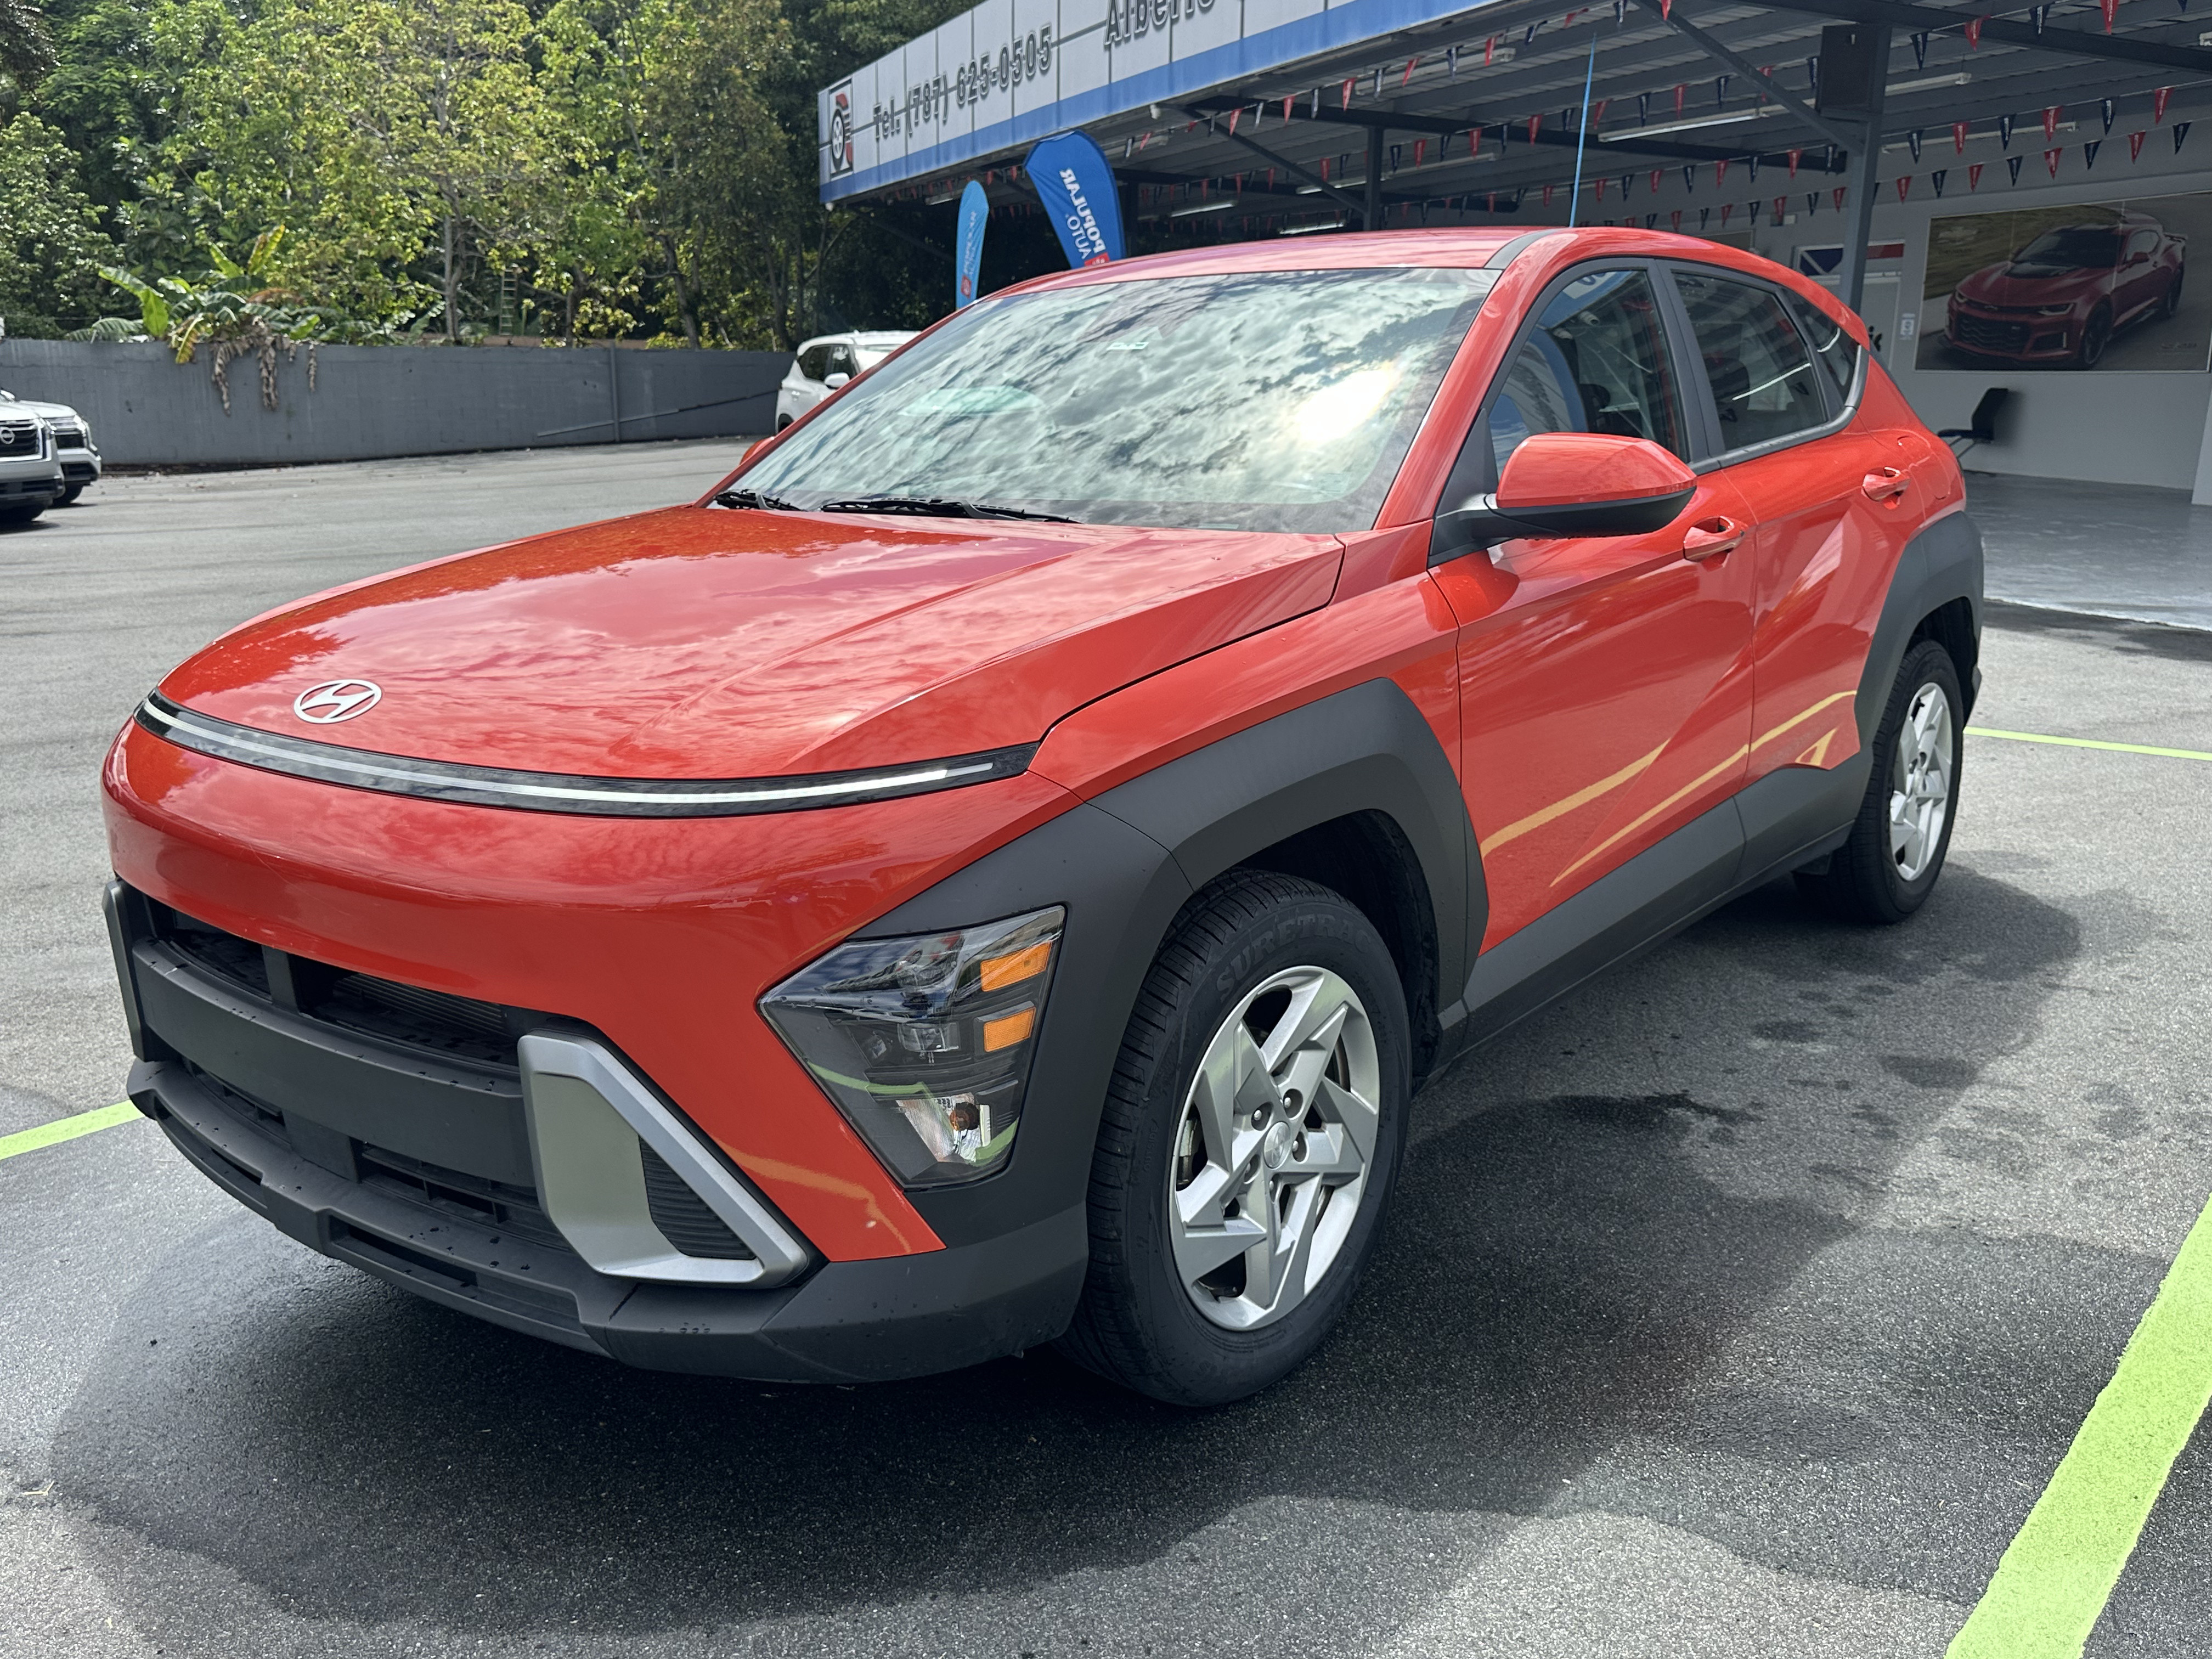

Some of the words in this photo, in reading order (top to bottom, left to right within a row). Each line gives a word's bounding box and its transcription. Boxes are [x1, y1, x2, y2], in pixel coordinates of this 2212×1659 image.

[1104, 0, 1214, 45] Albe
[873, 98, 900, 139] Tel.
[906, 72, 948, 134] (787)
[956, 24, 1052, 105] 625-0505
